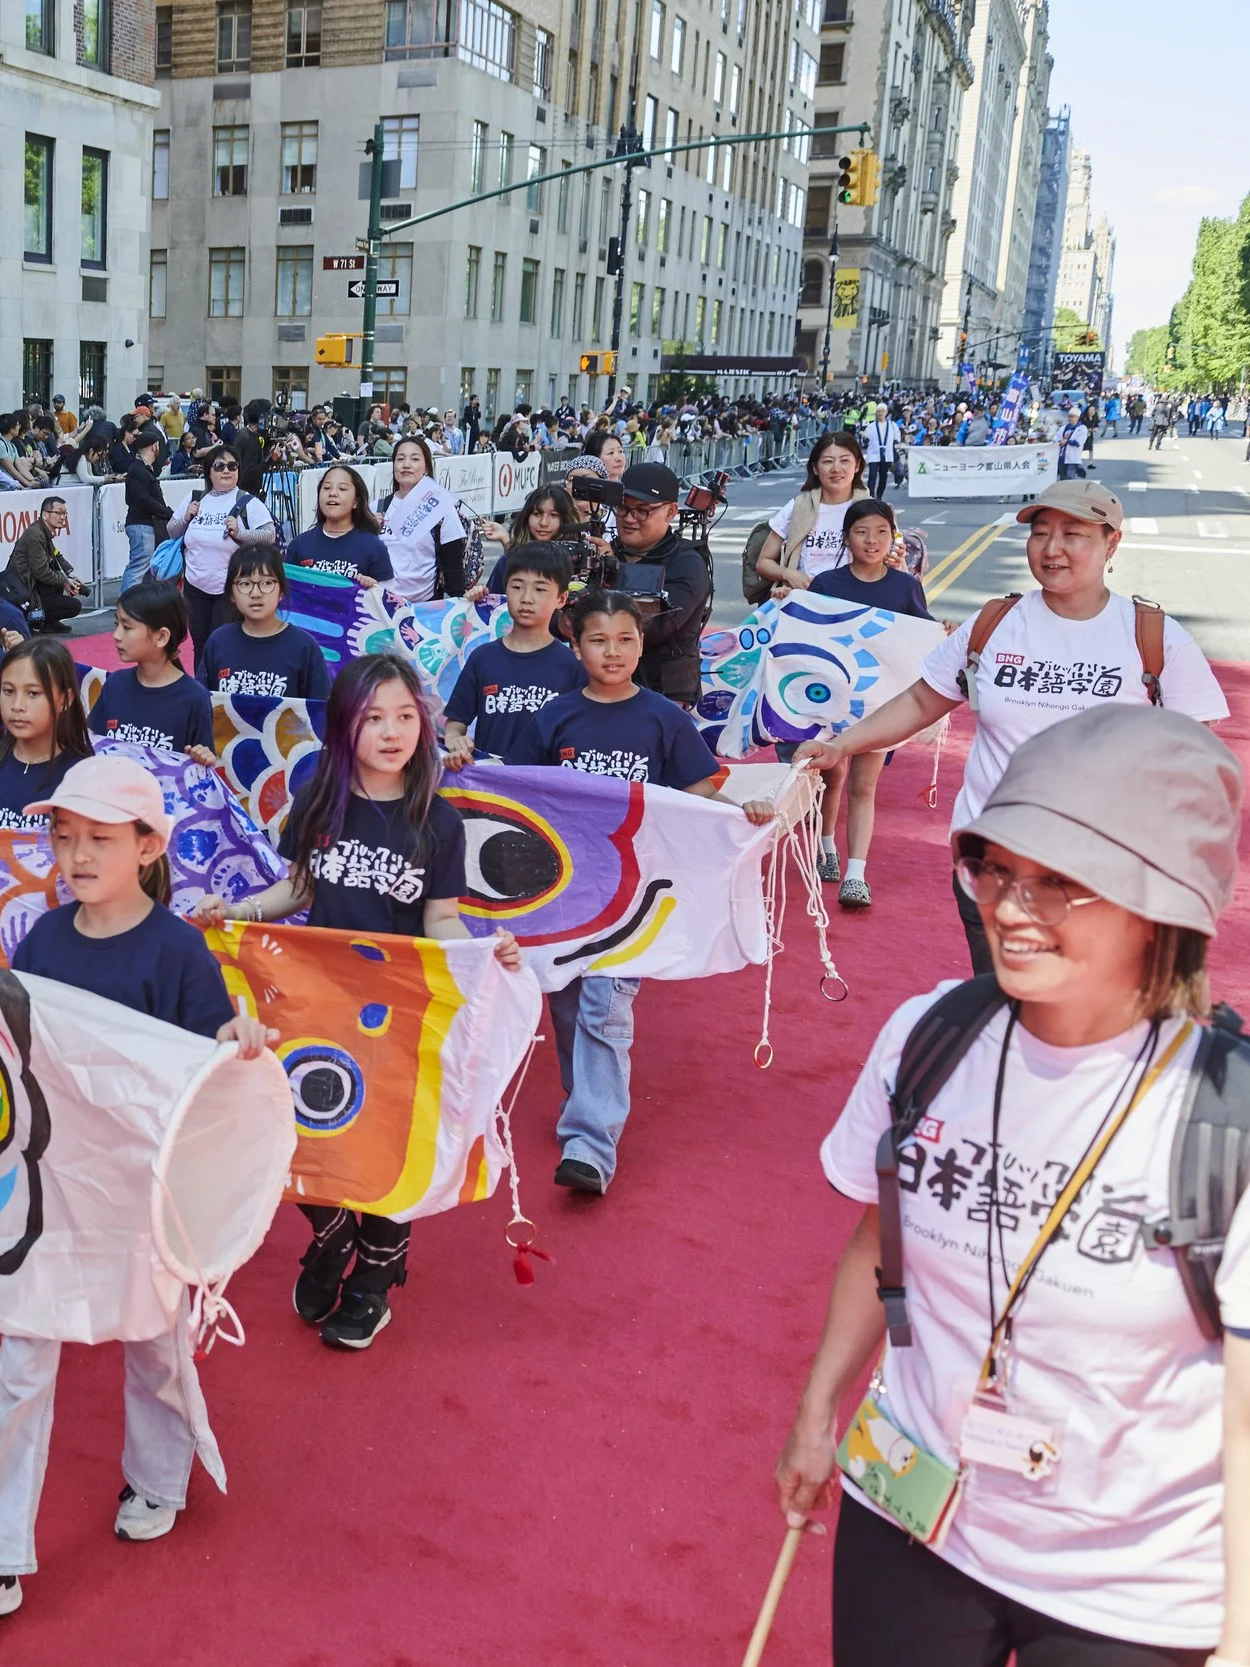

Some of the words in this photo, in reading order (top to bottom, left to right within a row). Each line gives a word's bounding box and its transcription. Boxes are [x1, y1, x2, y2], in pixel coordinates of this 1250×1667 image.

[333, 259, 339, 269] W
[340, 259, 347, 269] 71
[348, 259, 356, 269] St
[1058, 353, 1102, 363] TOYAMA
[997, 654, 1024, 665] BNG
[994, 664, 1122, 698] 日本語学園
[485, 690, 559, 714] 日本語学
[1004, 696, 1036, 708] Brooklyn
[1037, 702, 1070, 712] Nihongo
[581, 750, 649, 768] ブルックリン
[337, 839, 426, 876] ブルックリン
[903, 1213, 958, 1250] Brooklyn
